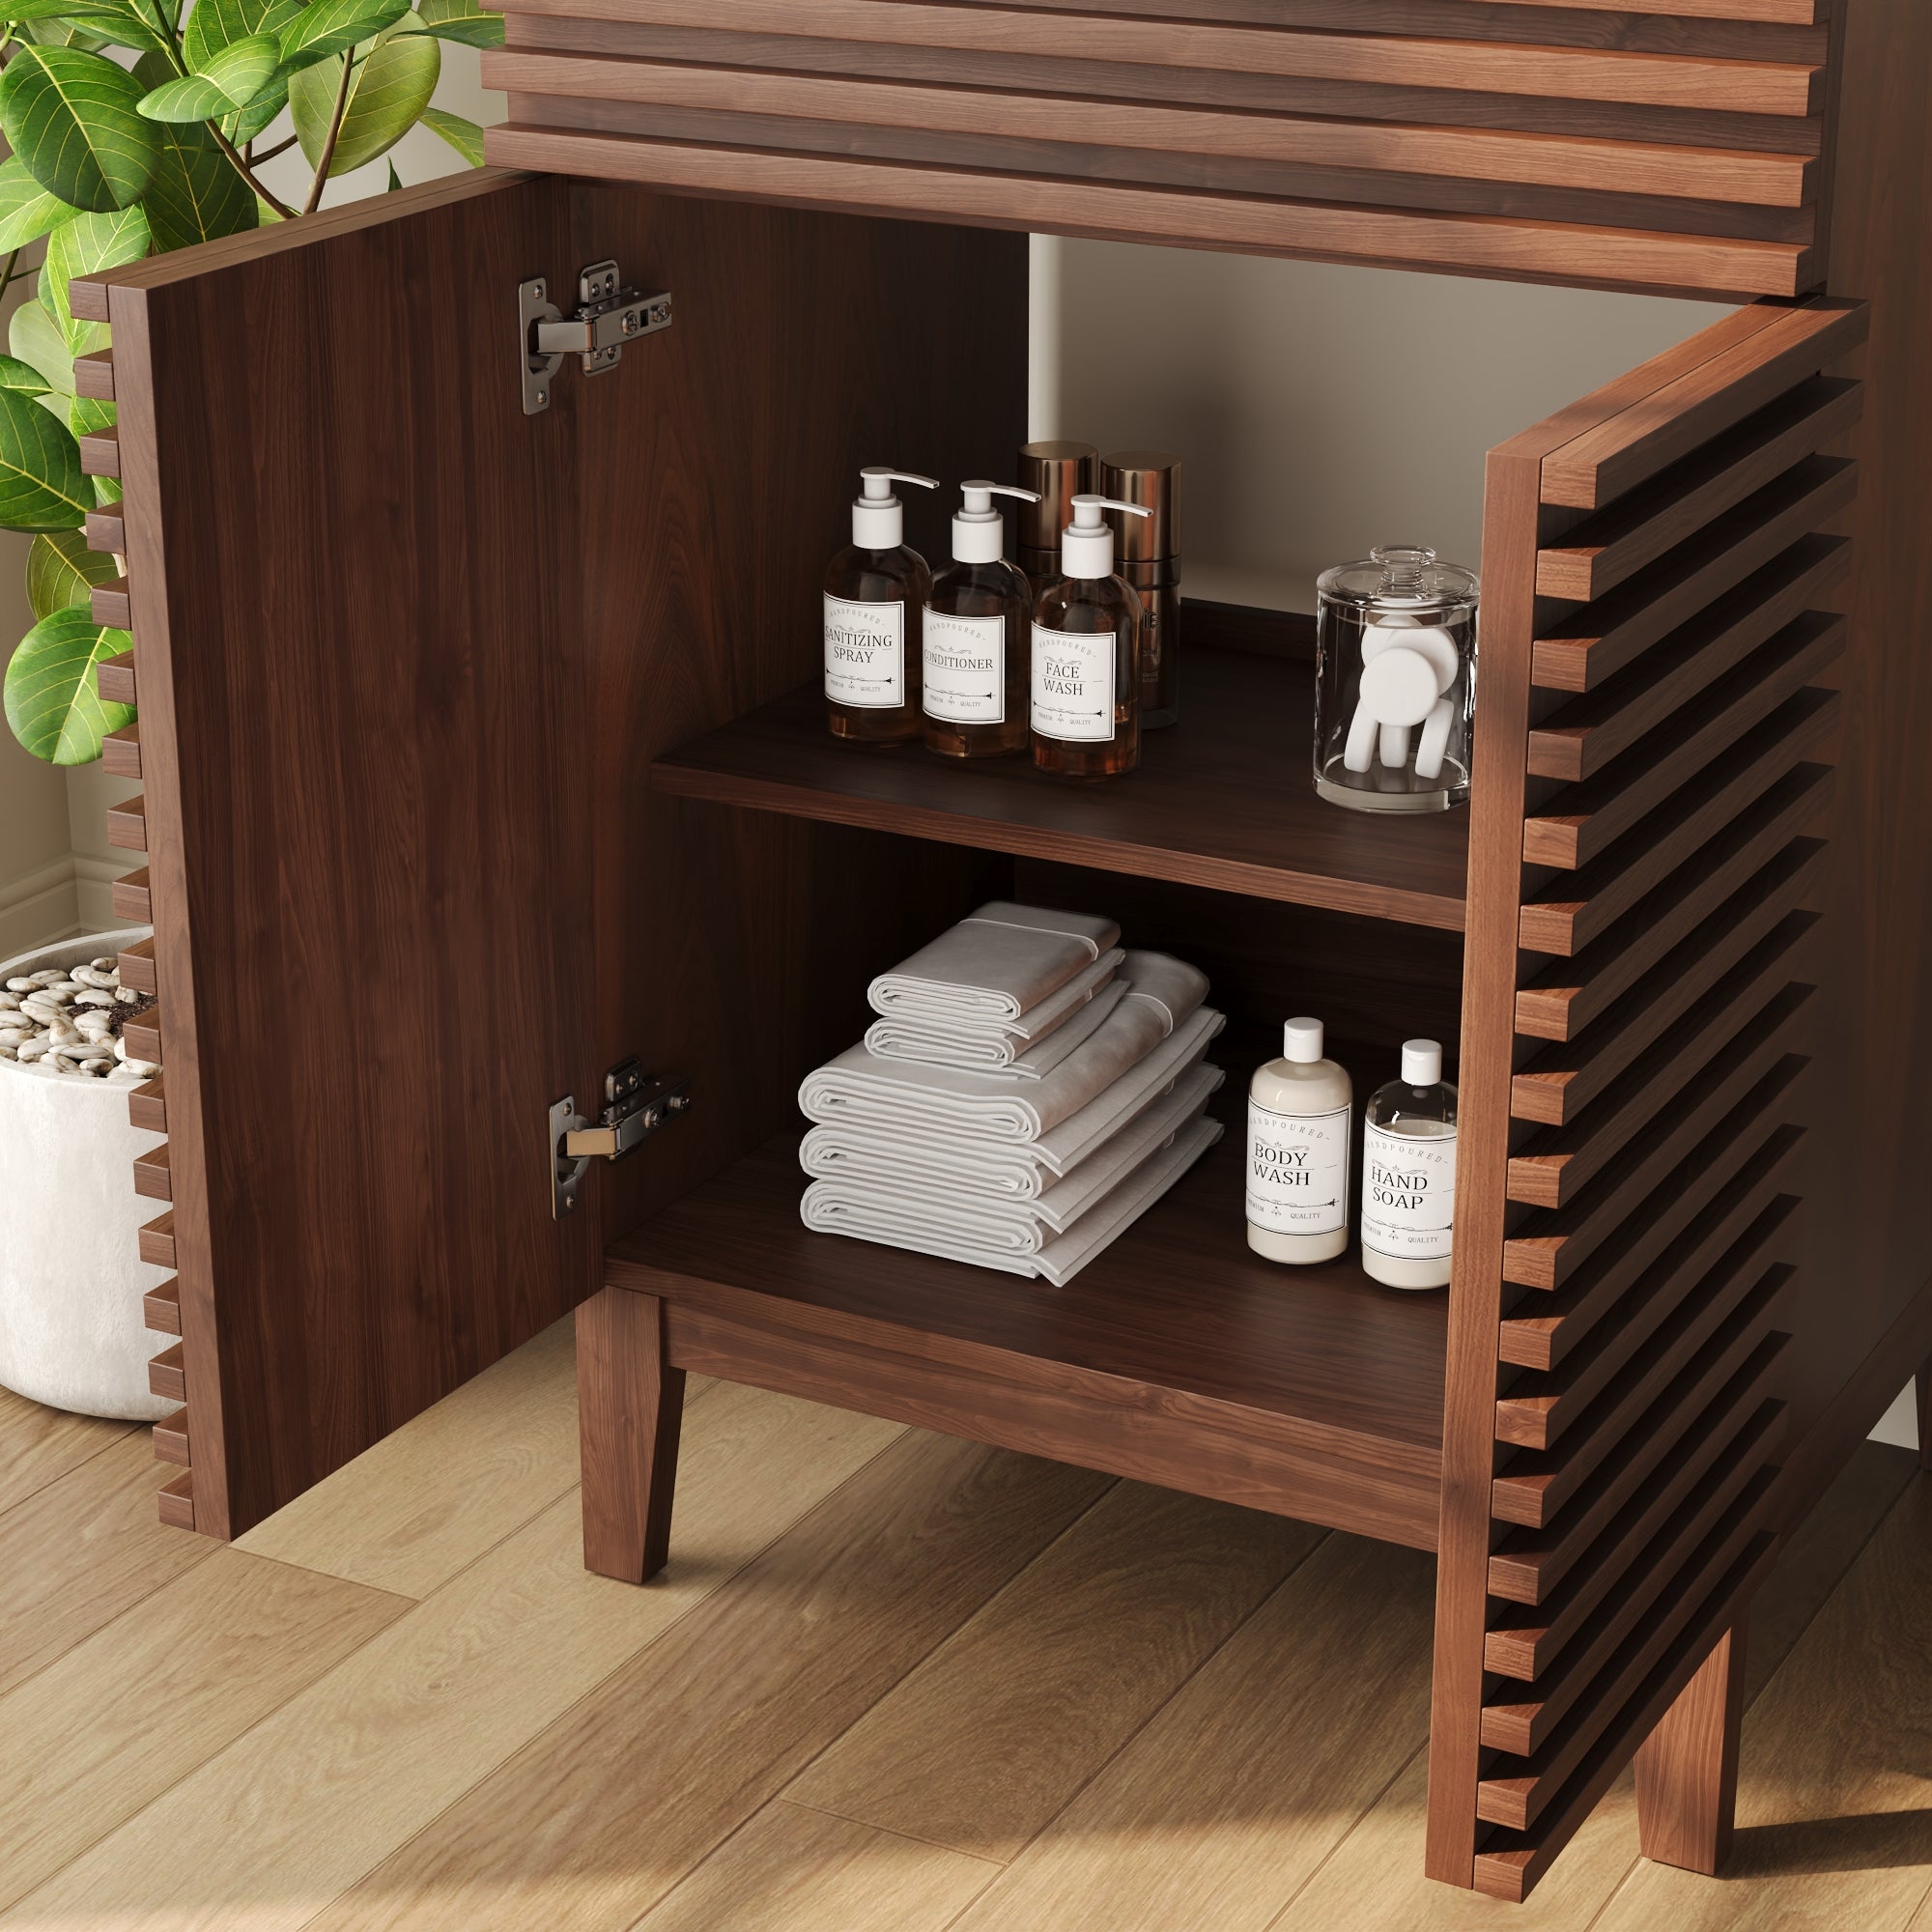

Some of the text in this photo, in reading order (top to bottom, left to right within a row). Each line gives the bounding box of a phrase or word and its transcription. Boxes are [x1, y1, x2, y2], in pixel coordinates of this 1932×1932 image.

[825, 625, 893, 647] SANITIZING
[834, 646, 873, 664] SPRAY
[924, 649, 994, 669] CONDITIONER
[1046, 662, 1080, 679] FACE
[1043, 678, 1084, 696] WASH
[1255, 1142, 1308, 1167] BODY
[1253, 1161, 1310, 1186] WASH
[1372, 1166, 1428, 1191] HAND
[1373, 1186, 1424, 1209] SOAP
